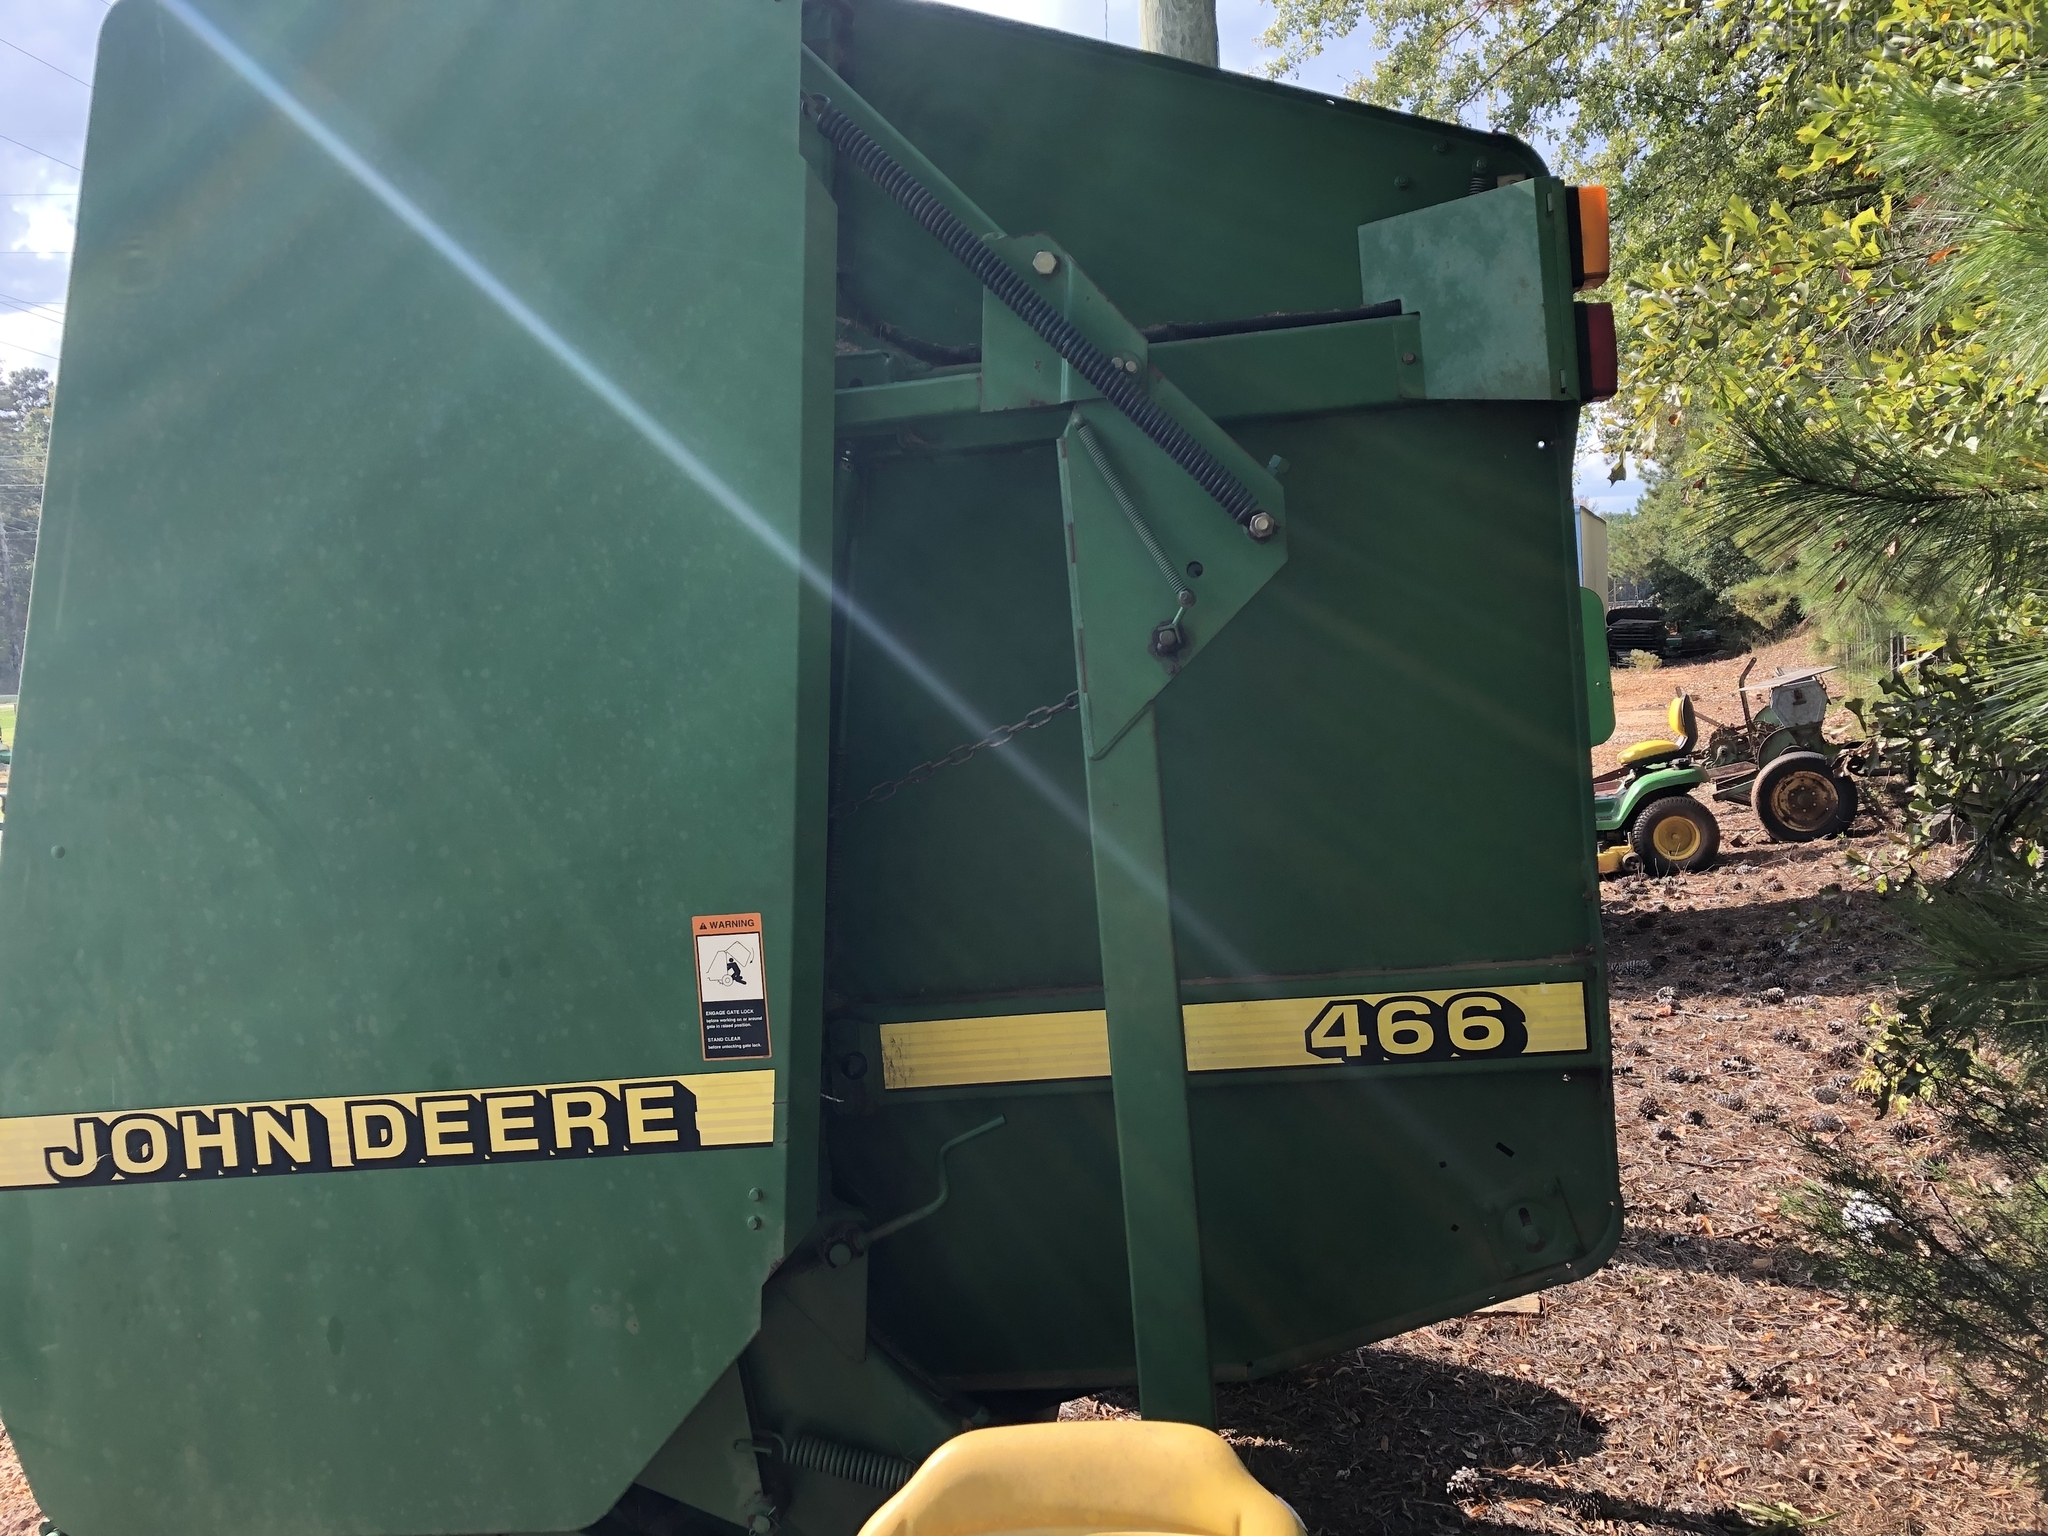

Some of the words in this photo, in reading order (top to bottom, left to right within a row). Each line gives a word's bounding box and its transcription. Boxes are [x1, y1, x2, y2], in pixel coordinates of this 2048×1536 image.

[709, 919, 755, 929] WARNING
[1310, 996, 1505, 1057] 466
[48, 1103, 312, 1181] JOHN
[346, 1085, 679, 1162] DEERE
